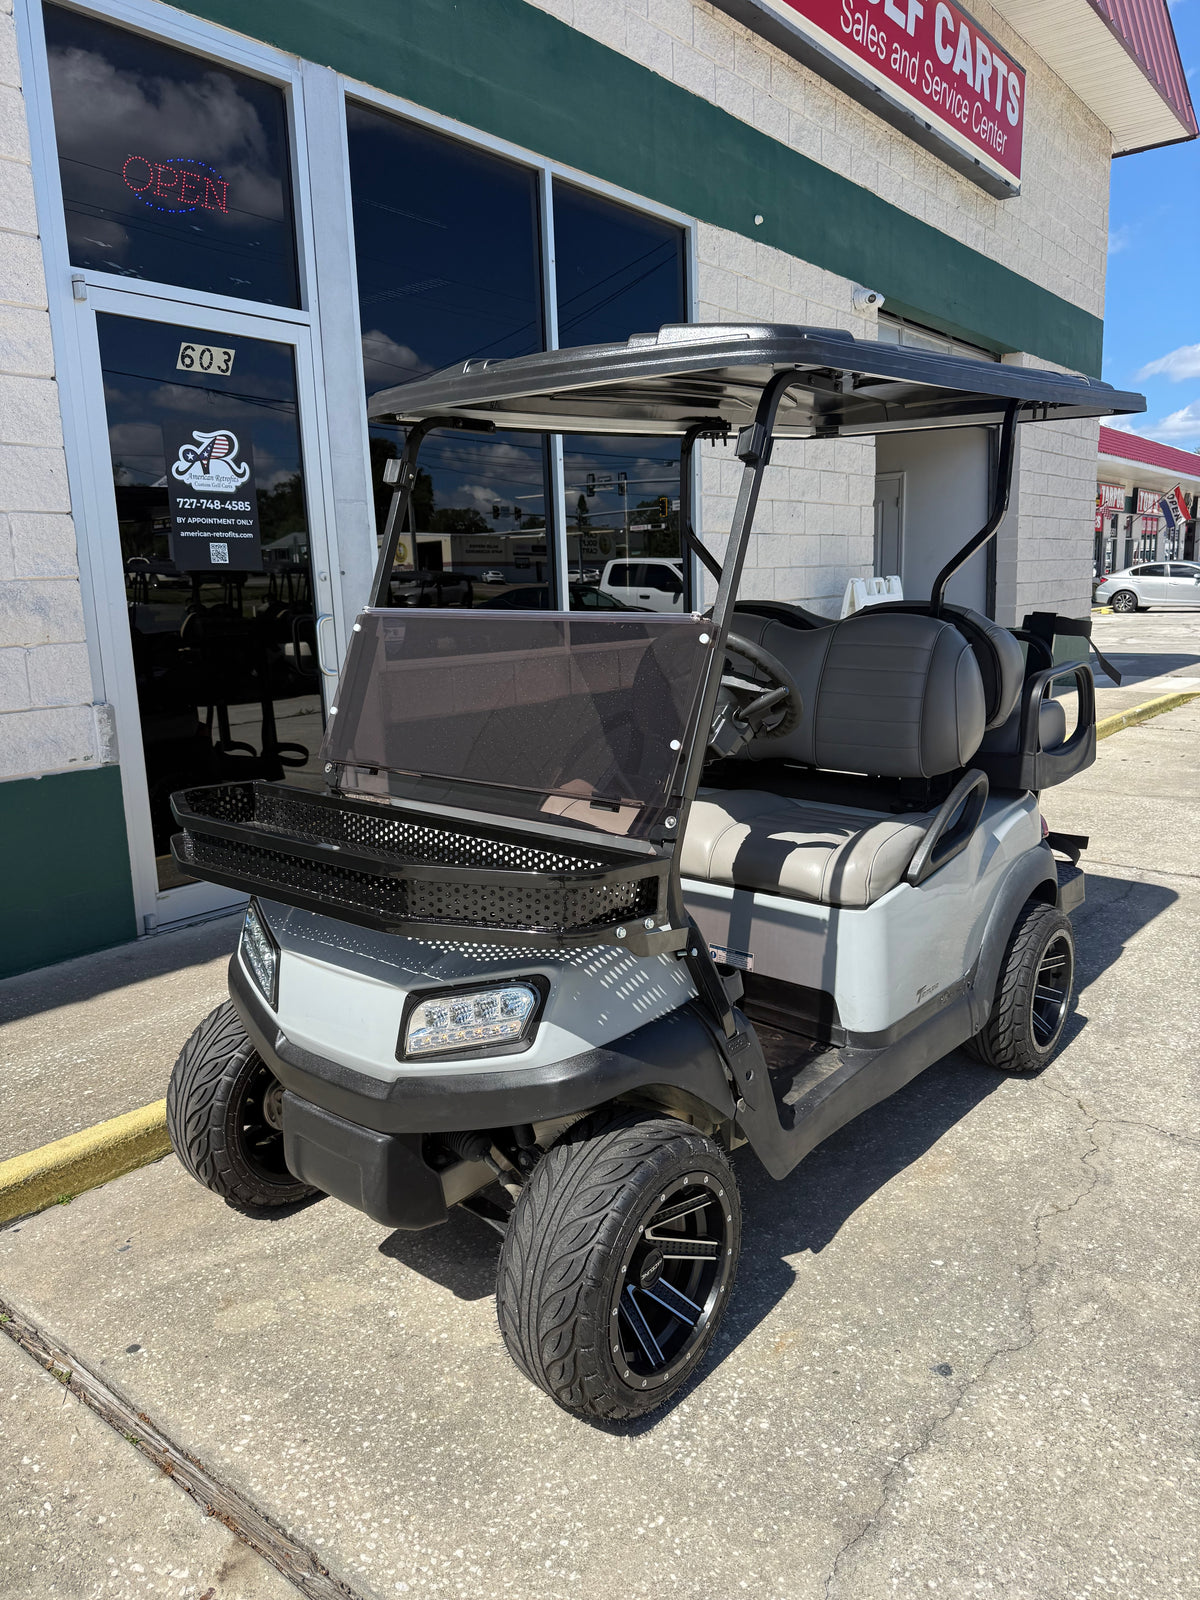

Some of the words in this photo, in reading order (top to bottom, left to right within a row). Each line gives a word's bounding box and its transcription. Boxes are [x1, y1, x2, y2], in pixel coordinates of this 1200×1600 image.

[840, 0, 887, 60] Sales
[890, 43, 920, 85] and
[922, 60, 970, 124] Service
[972, 102, 1008, 155] Center
[934, 2, 1020, 127] CARTS
[122, 155, 230, 214] OPEN
[181, 345, 231, 373] 603
[187, 473, 214, 482] American
[176, 498, 251, 511] 727-748-4585
[1167, 493, 1182, 524] OPEN
[180, 530, 254, 539] american-retrofits.com
